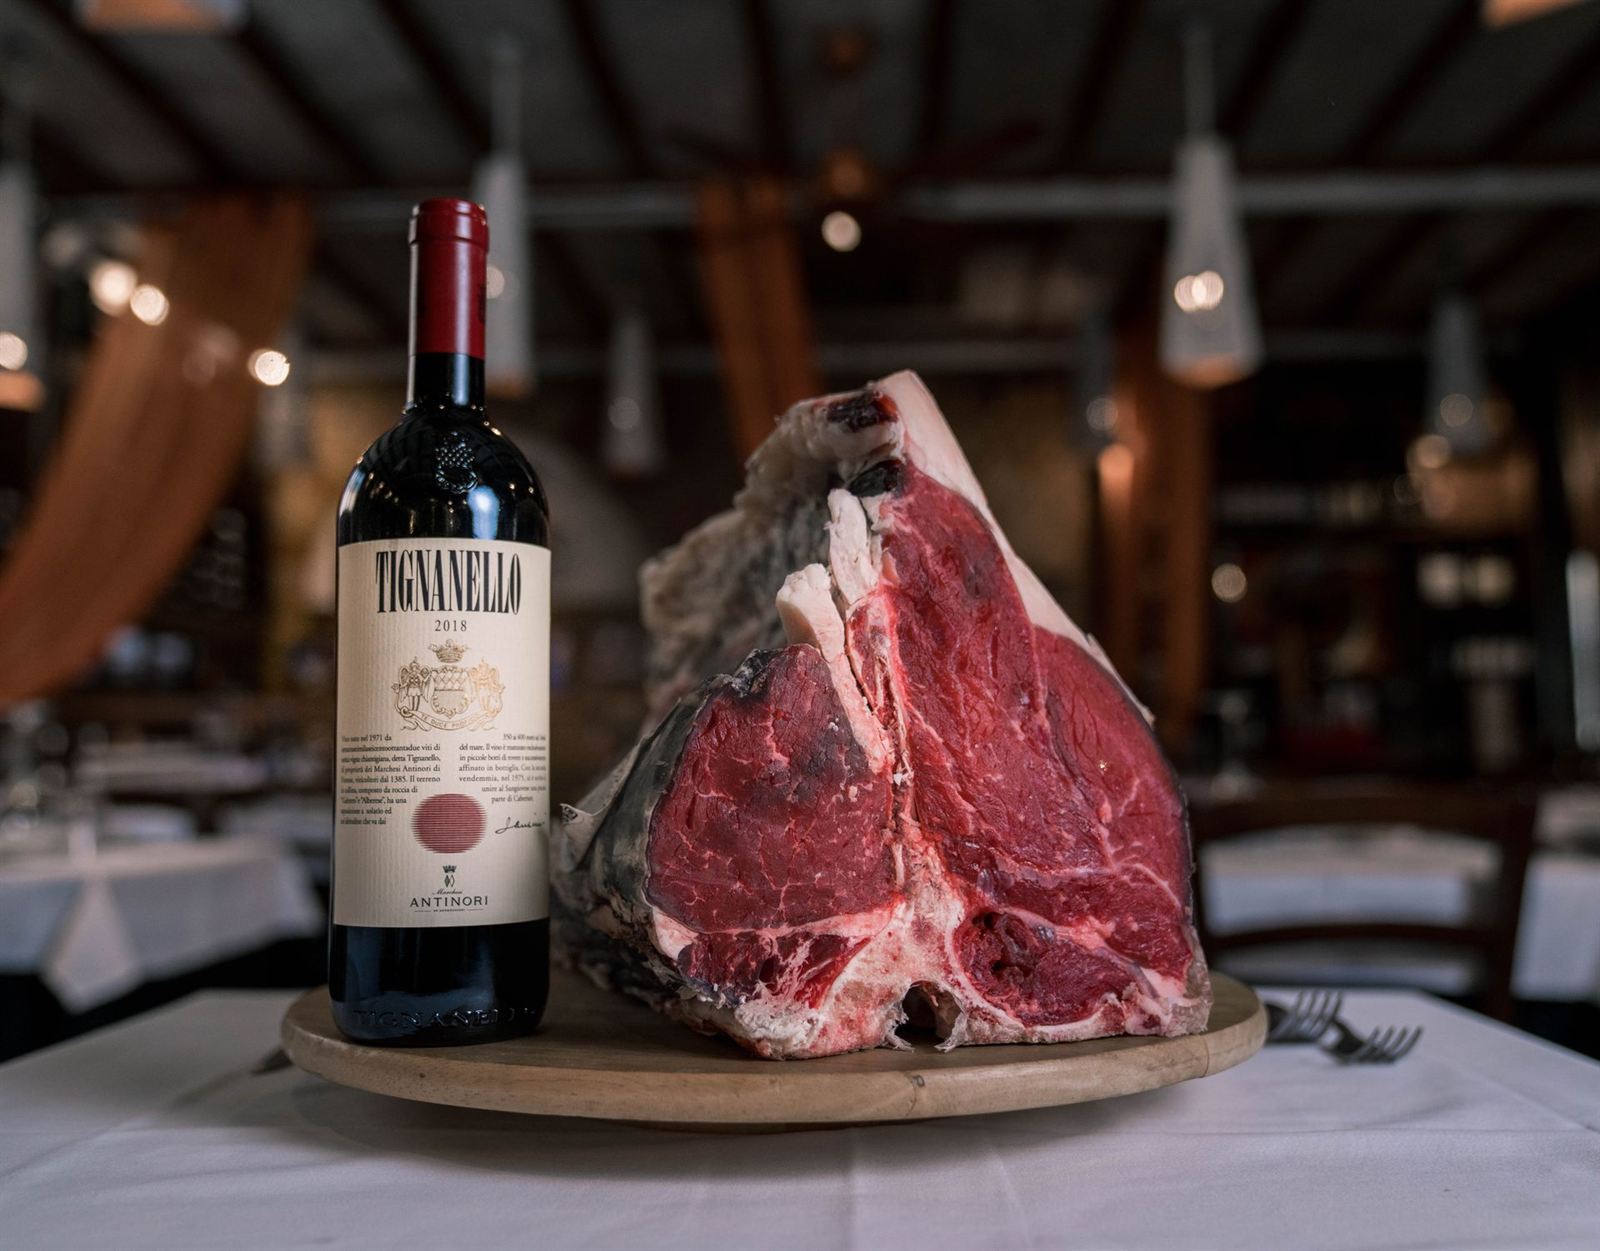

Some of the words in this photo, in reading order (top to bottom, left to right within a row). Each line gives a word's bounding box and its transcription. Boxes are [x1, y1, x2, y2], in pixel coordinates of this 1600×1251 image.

[375, 549, 521, 615] TIGNANELLO
[434, 619, 467, 632] 2018
[384, 733, 392, 741] da
[433, 743, 440, 751] di
[391, 754, 406, 762] detta
[406, 754, 441, 764] Tignanello,
[467, 755, 487, 763] piccole
[373, 764, 401, 772] Marchesi
[402, 764, 432, 772] Antinori
[433, 764, 441, 772] di
[459, 763, 485, 772] affinato
[380, 774, 389, 782] dal
[390, 775, 408, 783] 1385.
[409, 775, 415, 783] Il
[499, 784, 504, 792] al
[491, 796, 506, 804] parte
[410, 896, 488, 908] ANTINORI
